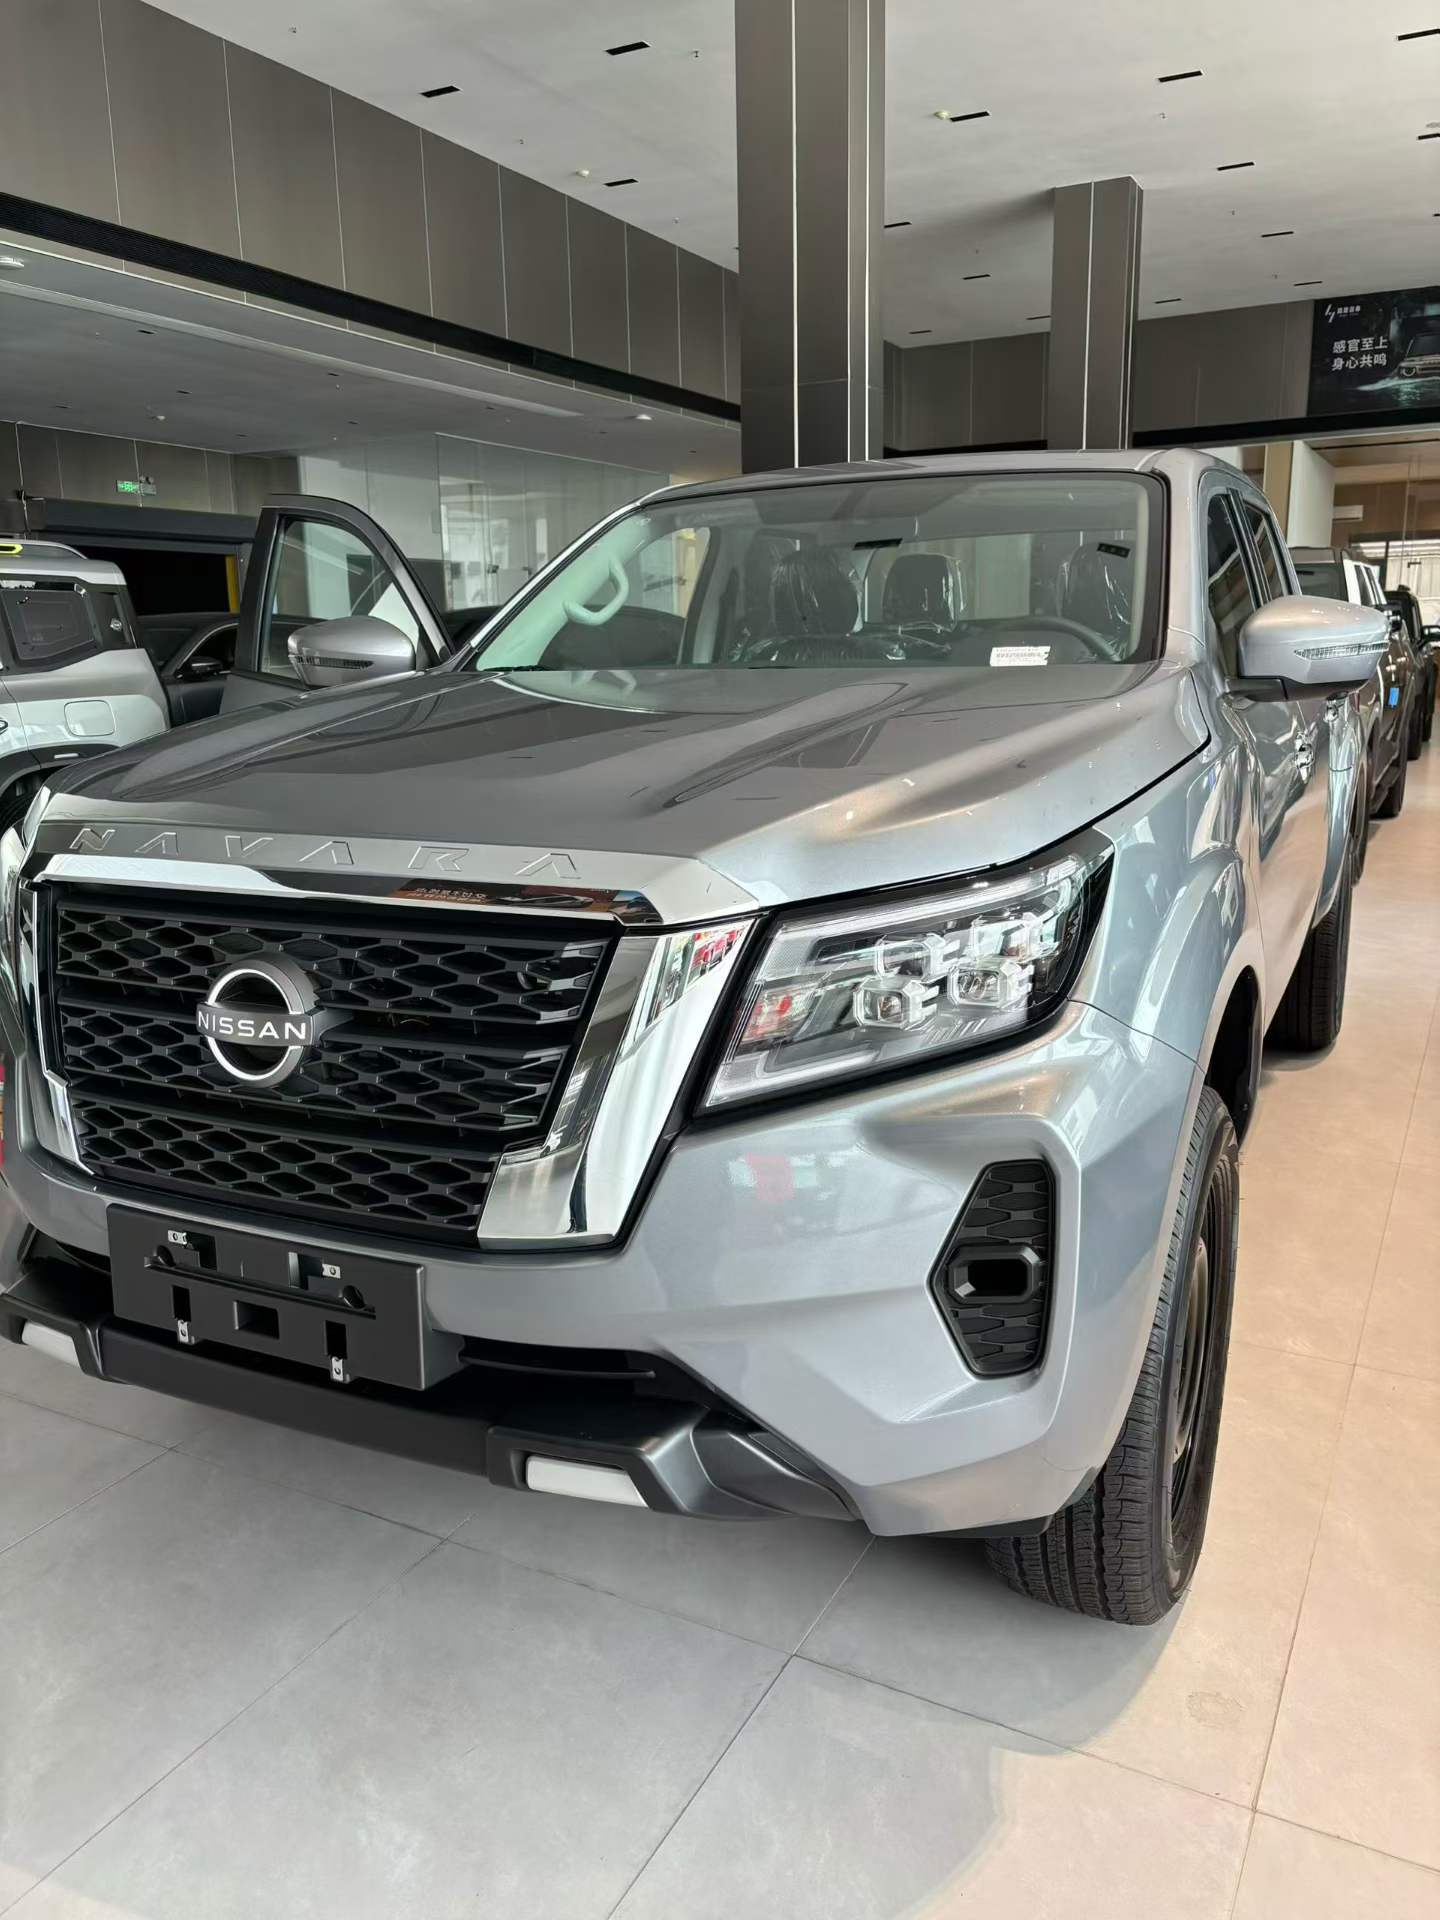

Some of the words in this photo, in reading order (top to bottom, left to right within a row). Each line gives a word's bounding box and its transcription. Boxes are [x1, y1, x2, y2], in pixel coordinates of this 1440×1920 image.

[1333, 336, 1388, 353] 感官至上
[1332, 353, 1387, 371] 身心共鸣
[69, 828, 582, 879] NAVARA
[198, 1010, 306, 1040] NISSAN
